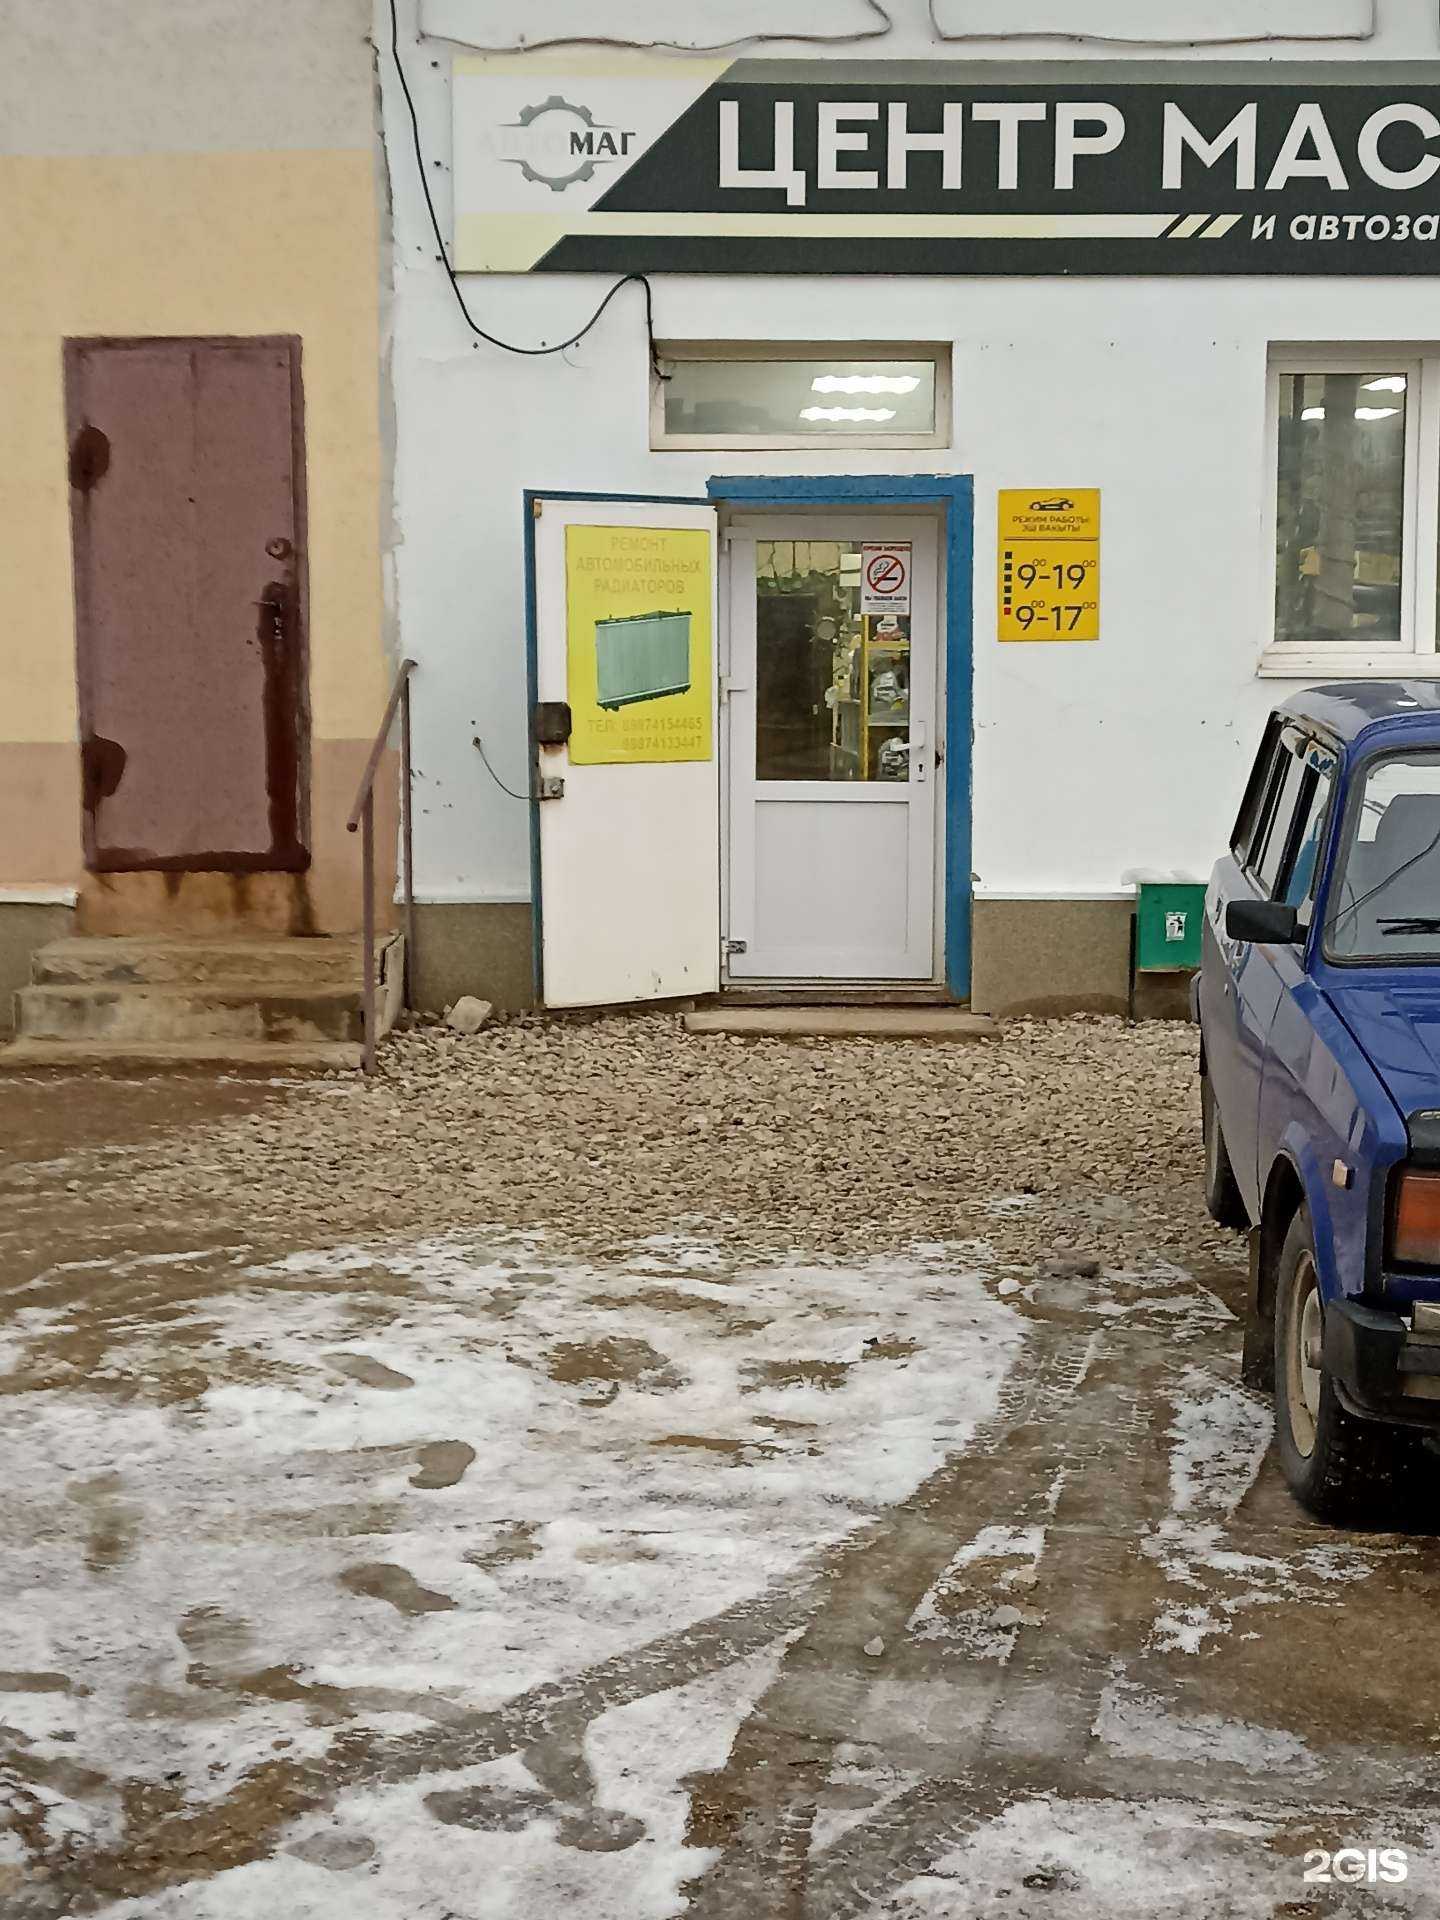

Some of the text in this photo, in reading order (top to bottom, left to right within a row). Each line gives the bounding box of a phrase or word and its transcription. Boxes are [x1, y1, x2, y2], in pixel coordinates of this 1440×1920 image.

[719, 100, 1440, 206] ЦЕНТР МАС
[1250, 214, 1440, 241] и автоза
[1012, 515, 1089, 523] РЕЖИМ РАБОТЫ
[610, 536, 667, 551] РЕМОНТ
[575, 556, 701, 574] АВТОМОБИЛЬНЫХ
[593, 578, 685, 594] РАДИАТОРОВ
